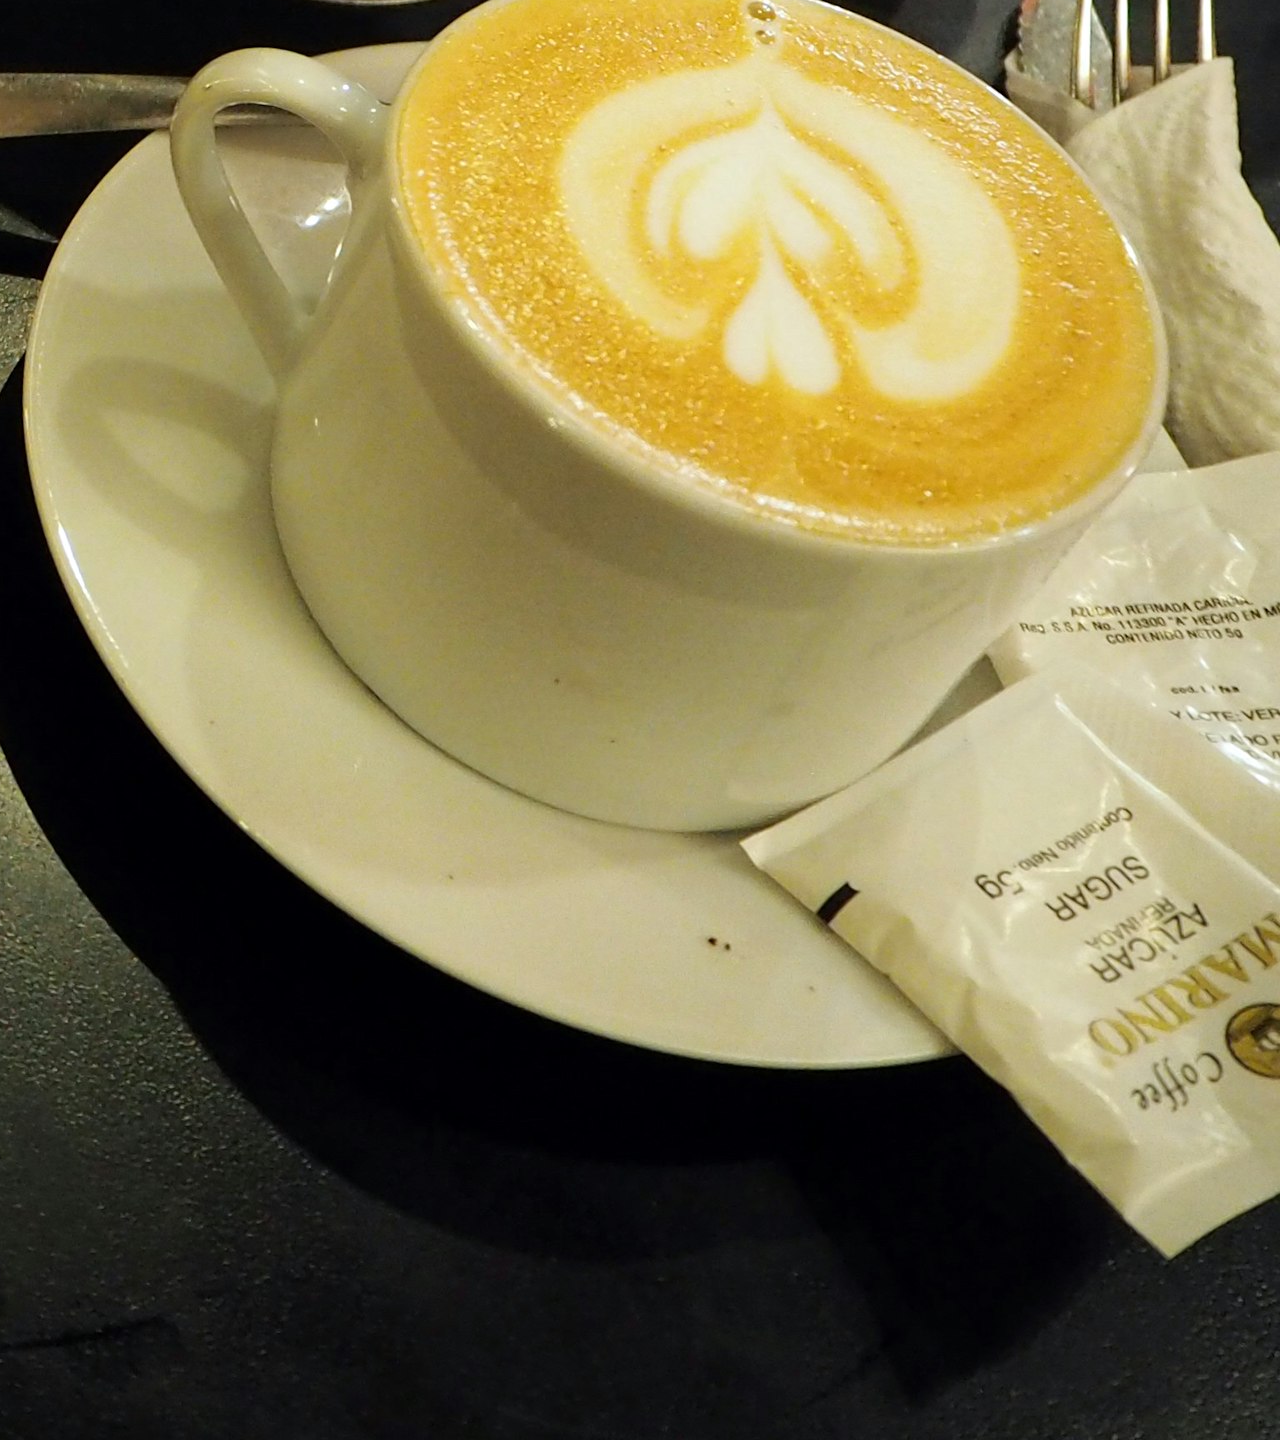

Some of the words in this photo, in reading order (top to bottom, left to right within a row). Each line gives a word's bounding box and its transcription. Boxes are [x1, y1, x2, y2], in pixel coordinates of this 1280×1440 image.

[1092, 621, 1116, 632] No.
[1118, 616, 1167, 630] 113300
[1192, 610, 1240, 626] HECHO
[1241, 608, 1262, 622] EN
[1125, 601, 1192, 616] REFINADA
[1106, 629, 1184, 645] CONTENIDO
[1186, 628, 1223, 640] NETO
[974, 870, 1023, 900] 5g
[1045, 855, 1149, 922] SUGAR
[1084, 897, 1177, 947] REFINADA
[1089, 903, 1209, 983] AZÚCAR
[1131, 1052, 1223, 1112] Coffee
